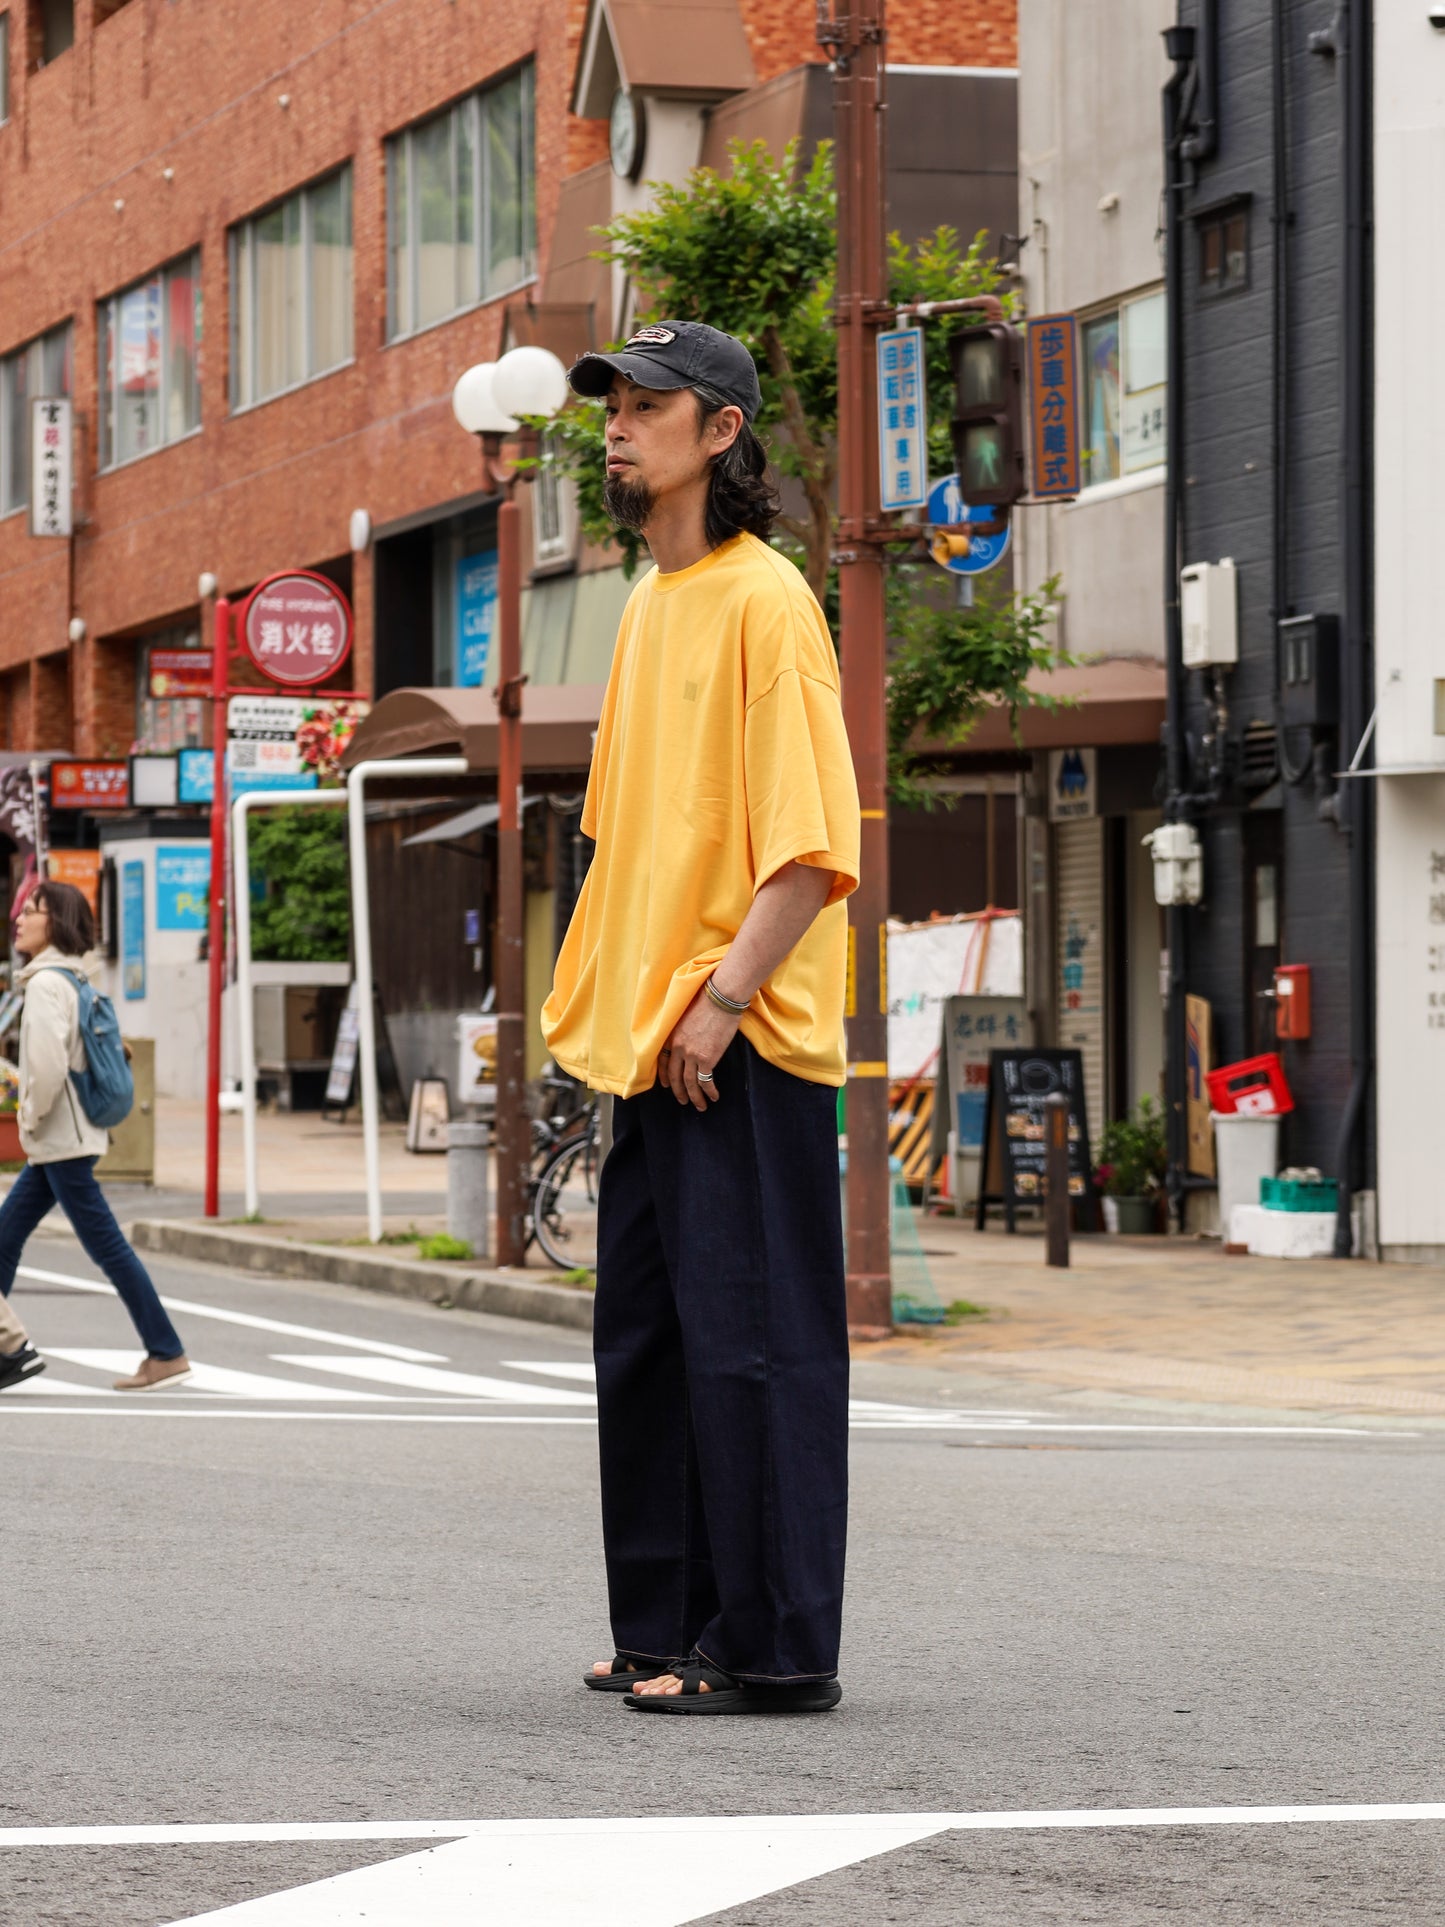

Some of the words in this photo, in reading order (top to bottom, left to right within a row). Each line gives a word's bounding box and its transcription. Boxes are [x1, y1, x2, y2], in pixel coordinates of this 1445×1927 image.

[884, 346, 901, 430] 自転車
[901, 342, 917, 429] 歩行者
[1039, 327, 1069, 487] 歩車分離式
[896, 438, 912, 496] 専用
[260, 598, 283, 611] FIRE
[286, 599, 335, 613] HYDRANT
[260, 621, 335, 655] 消火栓
